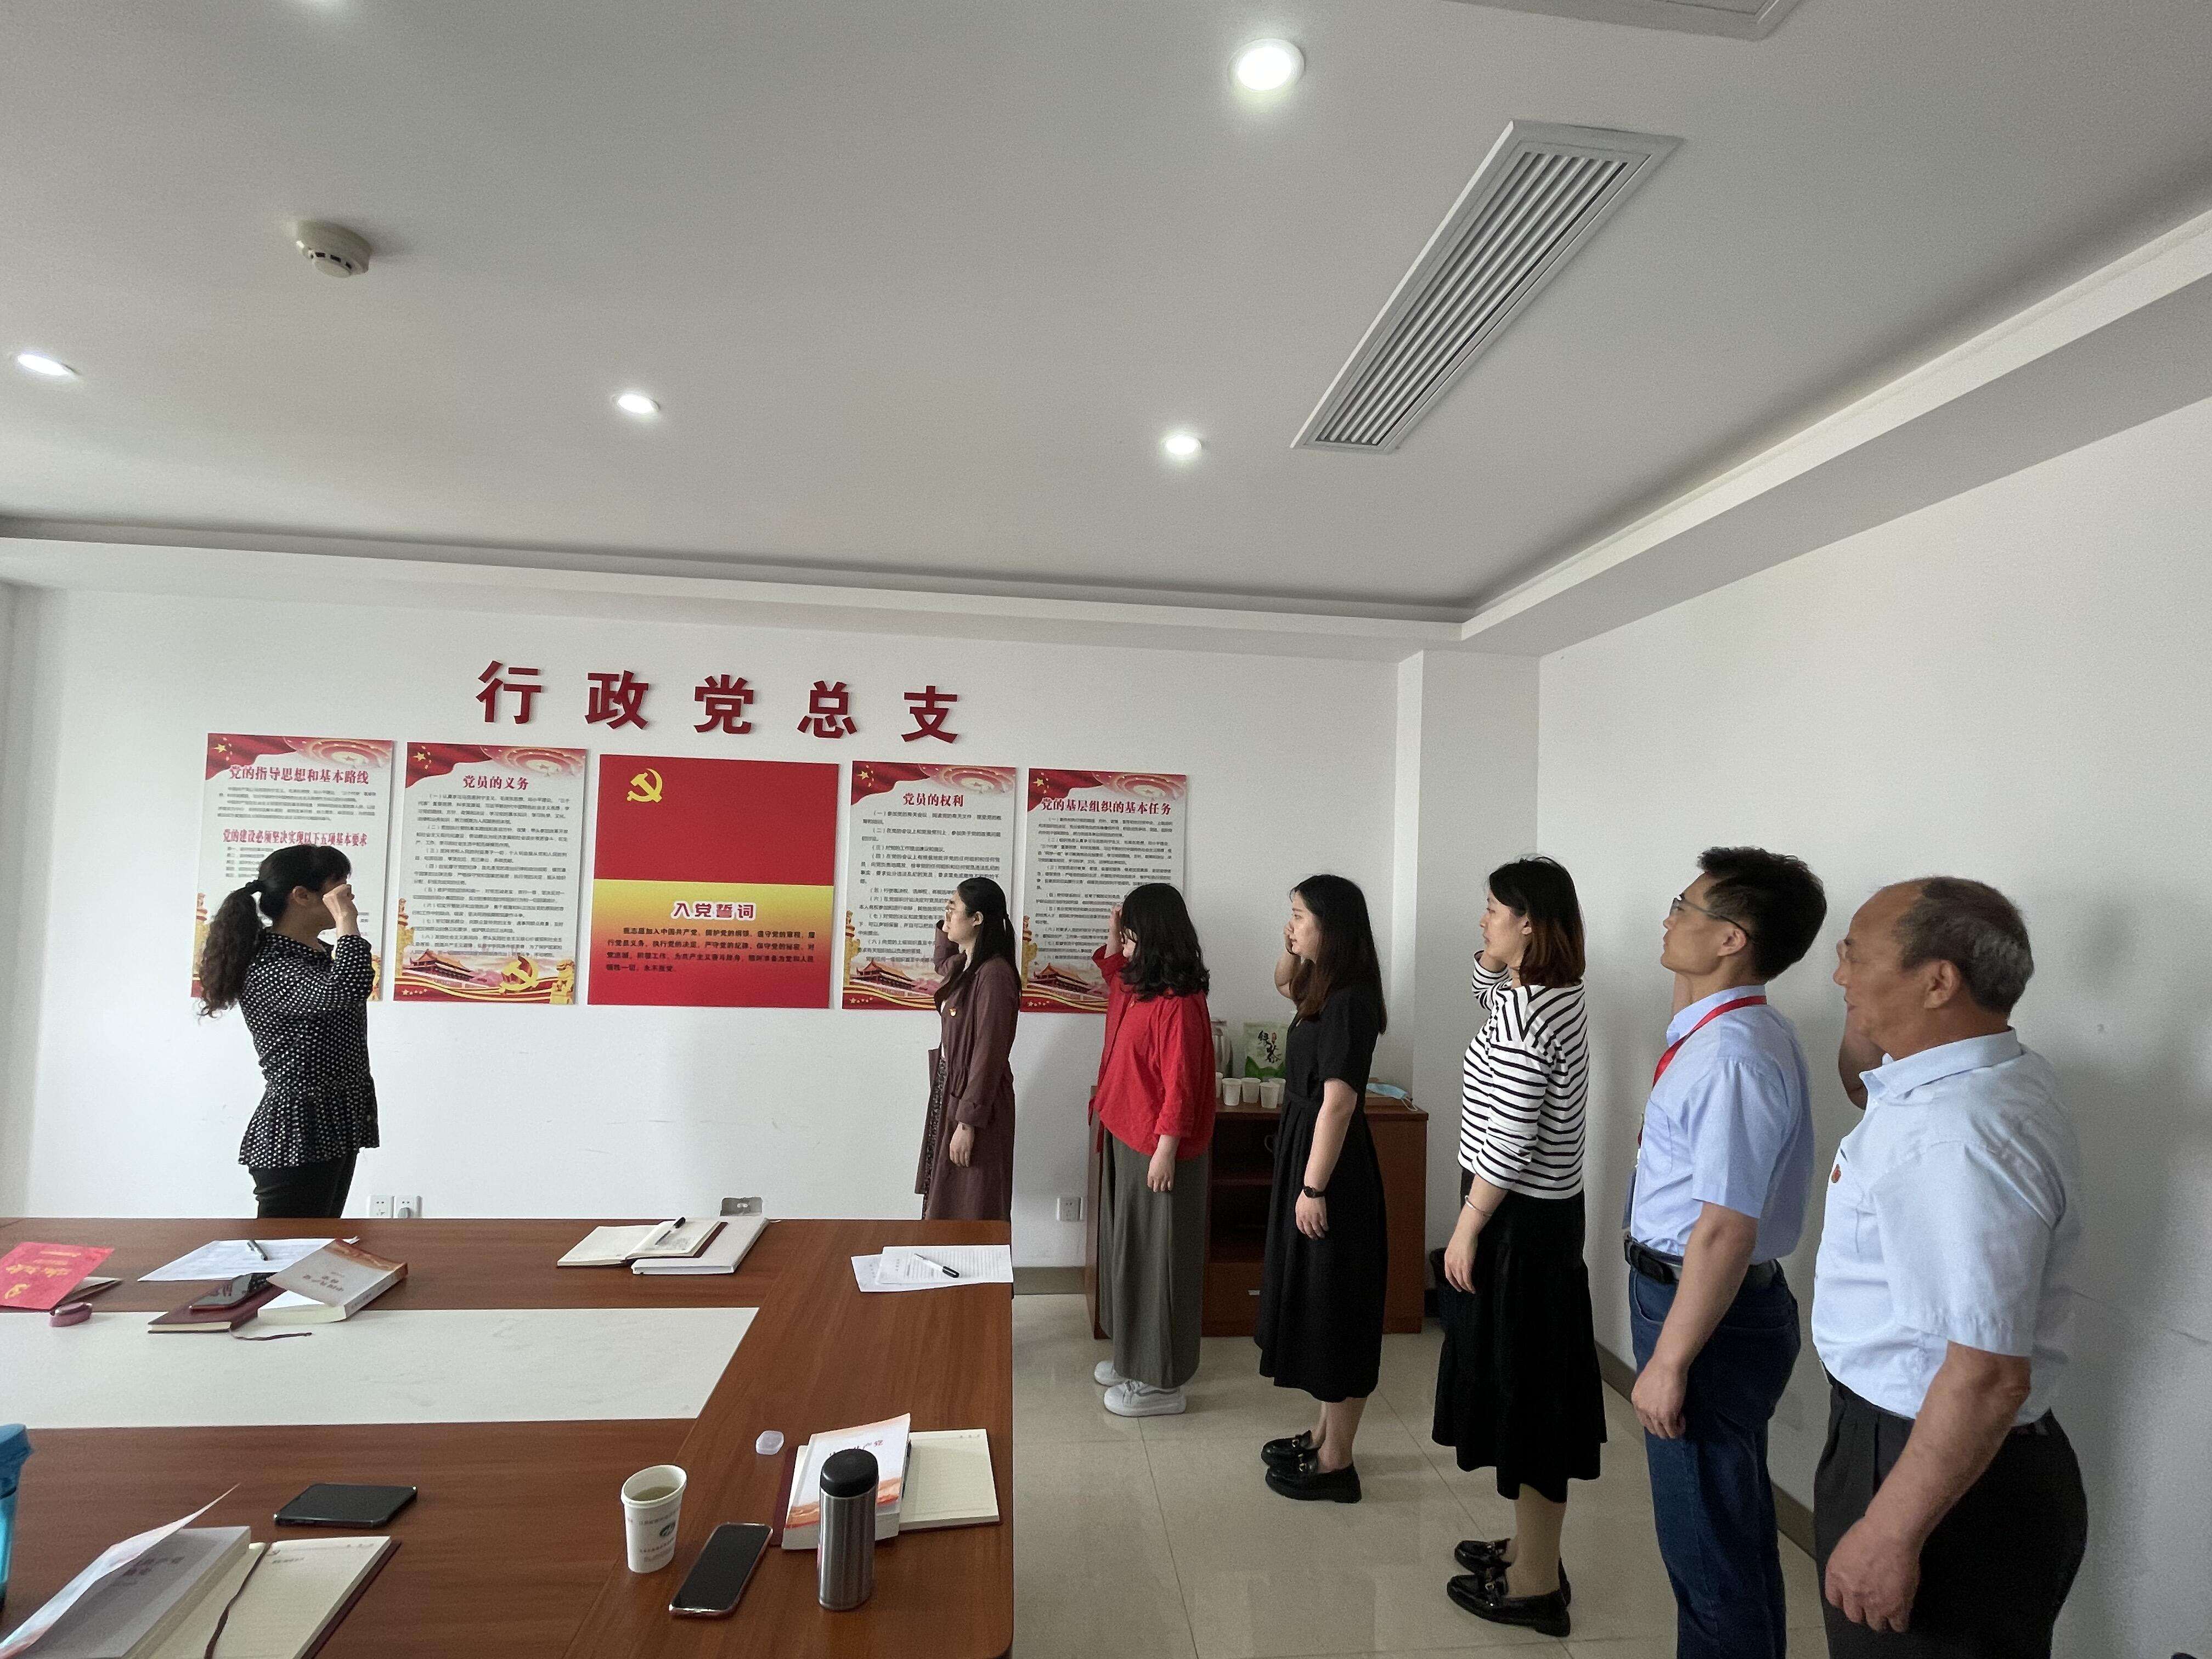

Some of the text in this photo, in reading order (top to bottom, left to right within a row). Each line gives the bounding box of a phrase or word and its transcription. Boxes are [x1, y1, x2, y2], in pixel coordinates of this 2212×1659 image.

[476, 660, 958, 743] 行政党总支
[229, 764, 369, 785] 党的指导思想和基本路线
[463, 775, 529, 791] 党员的义务
[903, 793, 964, 807] 党员的权利
[1042, 797, 1171, 815] 党的基层组织的基本任务
[673, 902, 755, 919] 入党誓词
